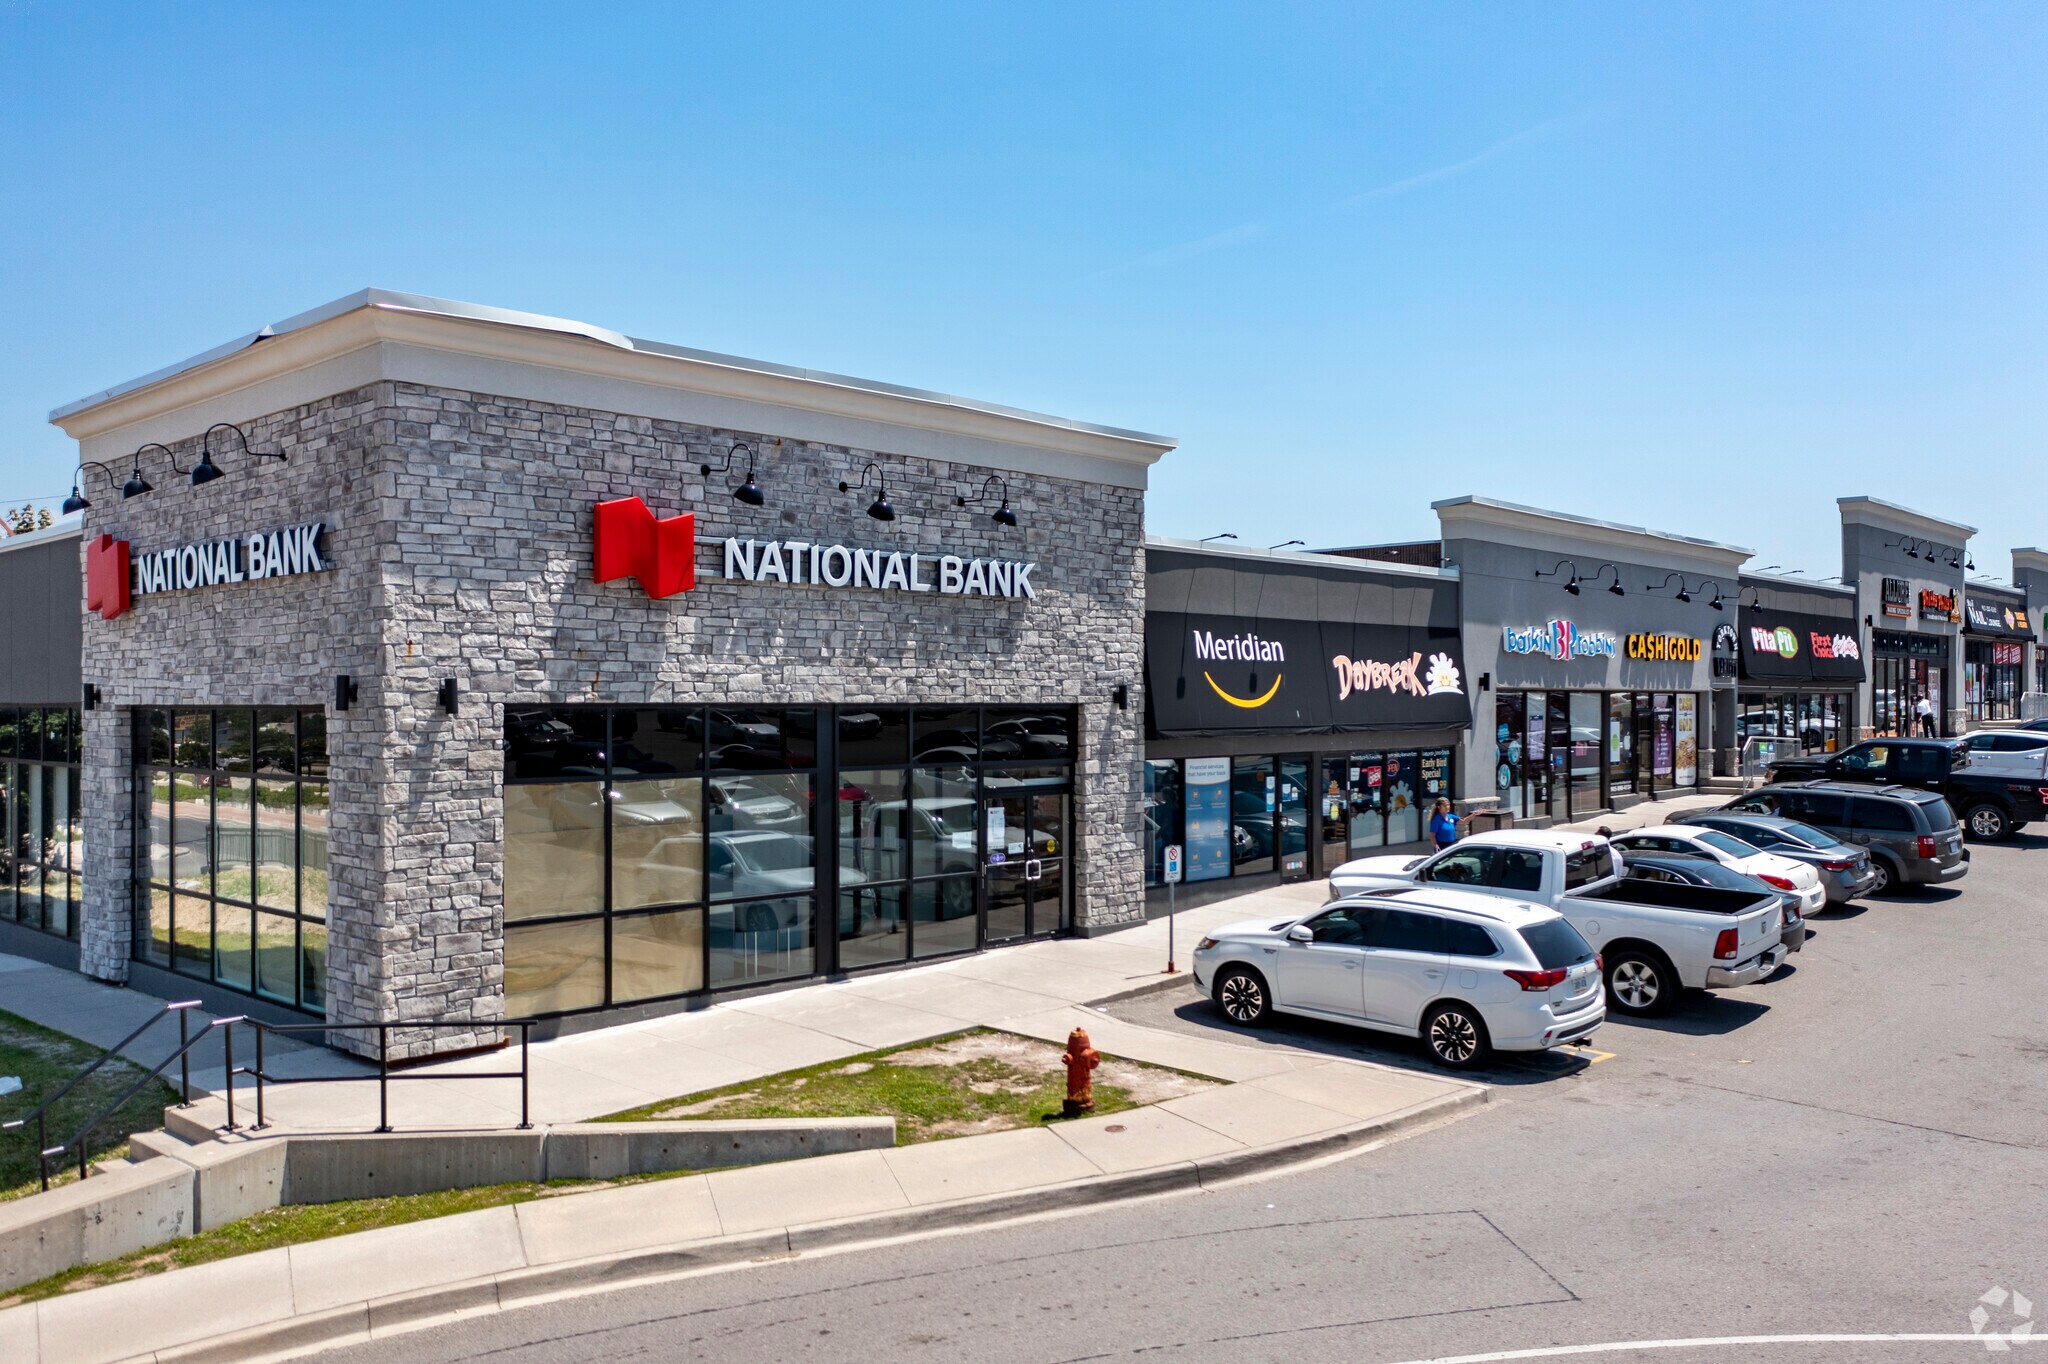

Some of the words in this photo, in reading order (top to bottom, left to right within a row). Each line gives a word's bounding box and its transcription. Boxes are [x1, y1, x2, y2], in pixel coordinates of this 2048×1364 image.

[138, 539, 245, 595] NATIONAL
[249, 523, 324, 580] BANK
[724, 537, 931, 592] NATIONAL
[940, 555, 1036, 599] BANK
[1968, 606, 1988, 626] NAIL
[1193, 630, 1285, 662] Meridian
[1668, 637, 1702, 661] GOLD
[1751, 627, 1777, 652] Pita
[1776, 630, 1795, 653] Pit
[1810, 631, 1832, 647] First
[1421, 758, 1435, 770] Early
[1435, 757, 1447, 767] Bird
[1369, 771, 1381, 785] OPEN
[1421, 768, 1441, 780] Special
[1427, 780, 1447, 790] $.99
